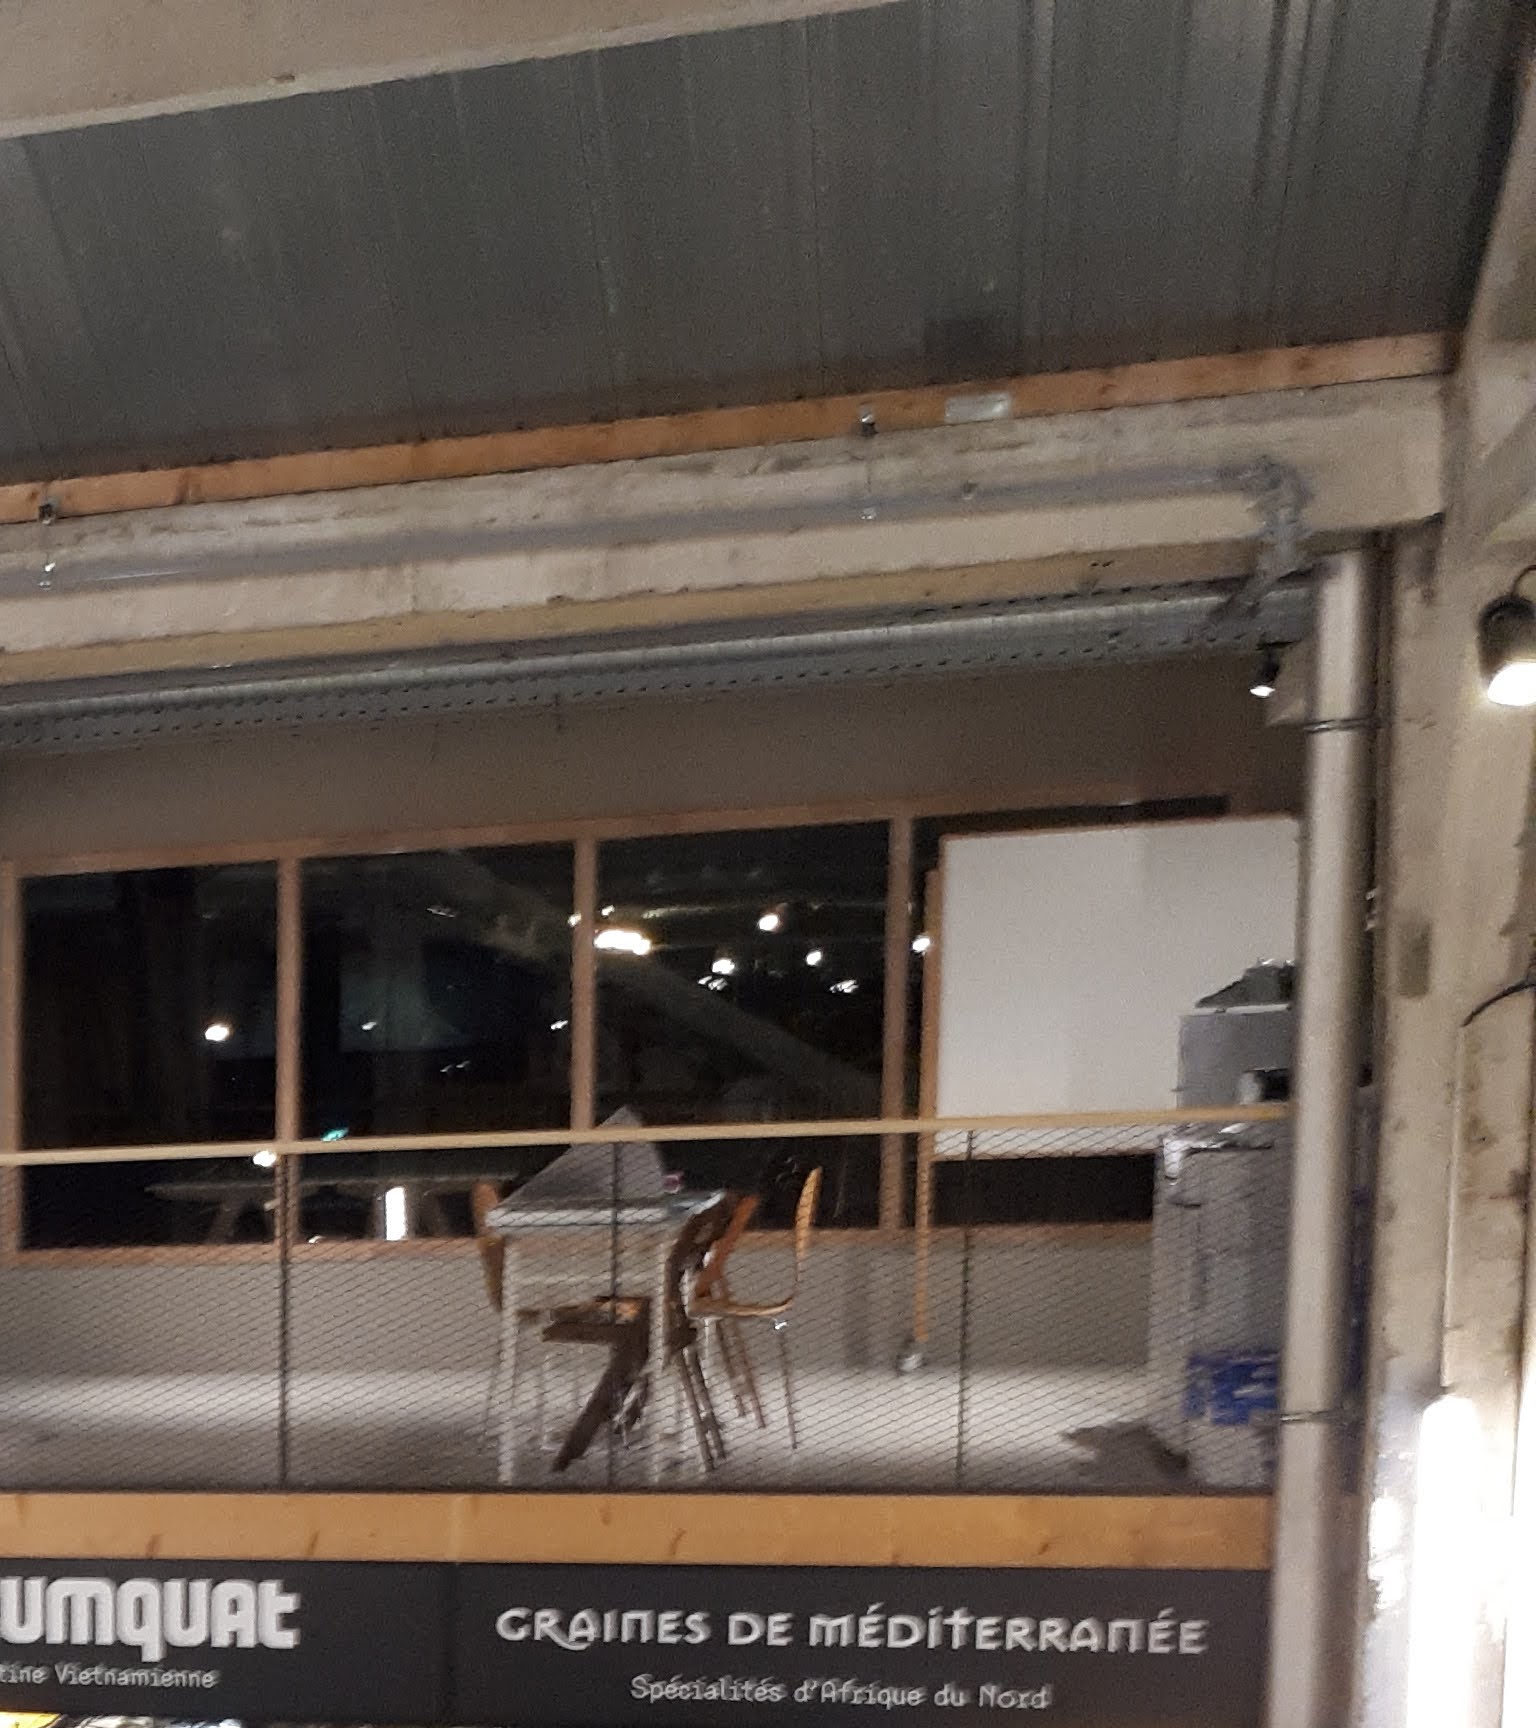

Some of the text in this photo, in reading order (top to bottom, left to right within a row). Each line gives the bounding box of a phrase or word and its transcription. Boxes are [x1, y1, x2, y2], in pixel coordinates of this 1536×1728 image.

[495, 1606, 711, 1650] GRAINES
[727, 1611, 794, 1647] DE
[54, 1663, 221, 1690] Vietnamienne
[630, 1673, 1053, 1710] Spécialités d'Afrique du Nord
